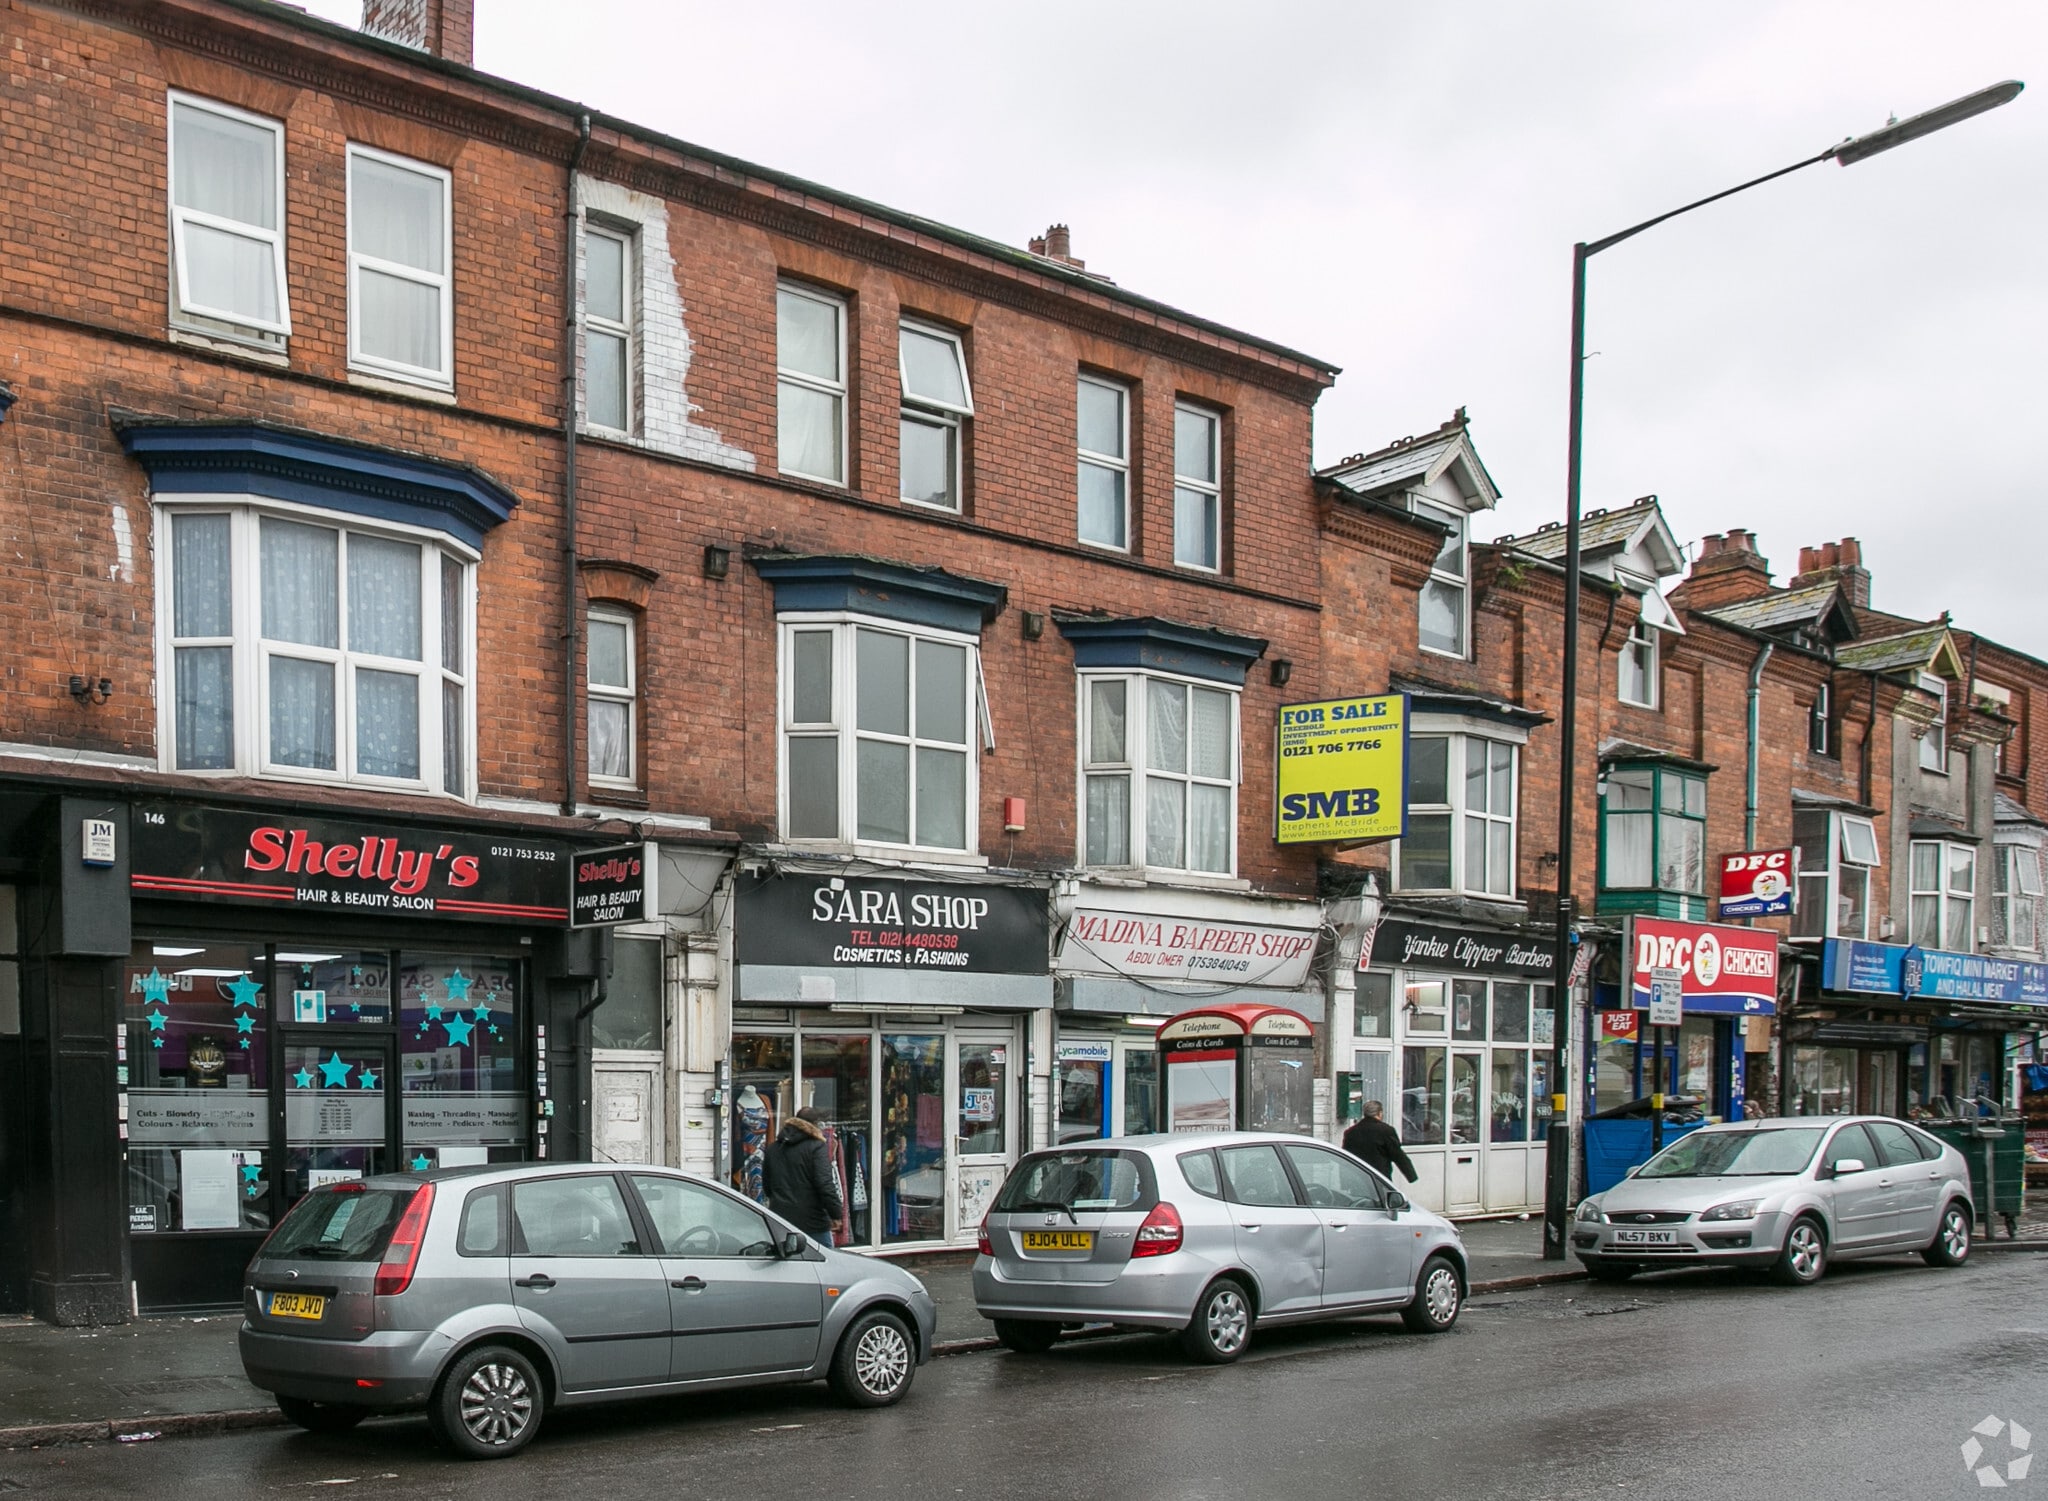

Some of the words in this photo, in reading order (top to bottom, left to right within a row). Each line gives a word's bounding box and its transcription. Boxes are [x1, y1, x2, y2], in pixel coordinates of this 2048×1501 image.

[1283, 708, 1325, 725] FOR
[1332, 702, 1387, 720] SALE
[1283, 723, 1325, 733] FREEHOLD
[1283, 729, 1338, 740] INVESTMENT
[1340, 723, 1399, 735] OPPORTUNITY
[1283, 746, 1314, 757] 0121
[1318, 743, 1343, 754] 706
[1347, 739, 1382, 751] 7766
[1282, 788, 1380, 821] SMB
[144, 812, 166, 825] 146
[1281, 821, 1330, 833] Stephens
[1334, 817, 1380, 827] McBride
[91, 822, 112, 837] JM
[1281, 824, 1399, 839] www.smbsurveyors.com
[244, 827, 480, 895] Shelly's
[491, 846, 513, 857] 0121
[516, 848, 532, 859] 753
[534, 850, 556, 861] 2532
[578, 856, 641, 883] Shelly's
[1725, 853, 1786, 872] DFC
[296, 888, 327, 903] HAIR
[330, 890, 342, 904] &
[345, 892, 390, 908] BEAUTY
[392, 895, 434, 911] SALON
[576, 895, 598, 909] HAIR
[600, 895, 608, 906] &
[609, 889, 642, 904] BEAUTY
[593, 906, 624, 921] SALON
[812, 887, 904, 926] SARA
[911, 894, 988, 930] SHOP
[1726, 905, 1761, 913] CHICKEN
[851, 930, 878, 946] TEL.
[1072, 915, 1163, 947] MADINA
[1168, 925, 1257, 955] BARBER
[1256, 934, 1313, 960] SHOP
[833, 945, 901, 964] COSMETICS
[905, 952, 912, 963] &
[913, 947, 969, 966] FASHIONS
[1453, 936, 1502, 968] Clipper
[1505, 943, 1553, 968] Barbers
[1636, 934, 1692, 976] DFC
[1125, 949, 1157, 965] ABDU
[1157, 951, 1184, 967] OMER
[1188, 956, 1250, 972] 07538410491
[1725, 950, 1773, 976] CHICKEN
[1924, 954, 1962, 977] TOWFIQ
[1963, 958, 1982, 978] MINI
[1984, 961, 2018, 981] MARKET
[1653, 985, 1661, 1001] P
[1936, 978, 1954, 995] AND
[1956, 980, 1982, 997] HALAL
[1984, 982, 2005, 999] MEAT
[1268, 1019, 1296, 1030] Telephone
[1607, 1013, 1632, 1023] JUST
[1612, 1021, 1632, 1030] EAT
[1182, 1021, 1222, 1033] Telephone
[1176, 1040, 1196, 1049] Coins
[1195, 1039, 1202, 1047] &
[1203, 1038, 1224, 1047] Cards
[1264, 1036, 1279, 1046] Coins
[1284, 1037, 1300, 1046] Cards
[136, 1109, 158, 1118] Cuts
[166, 1109, 201, 1119] Blowdry
[408, 1110, 435, 1119] Waxing
[442, 1110, 481, 1119] Threading
[1535, 1105, 1553, 1117] SHO
[138, 1120, 173, 1128] Colours
[1028, 1233, 1058, 1247] BJ04
[1061, 1234, 1087, 1247] ULL
[1618, 1232, 1645, 1242] NL57
[273, 1294, 299, 1311] FB03
[300, 1296, 322, 1314] JVD
